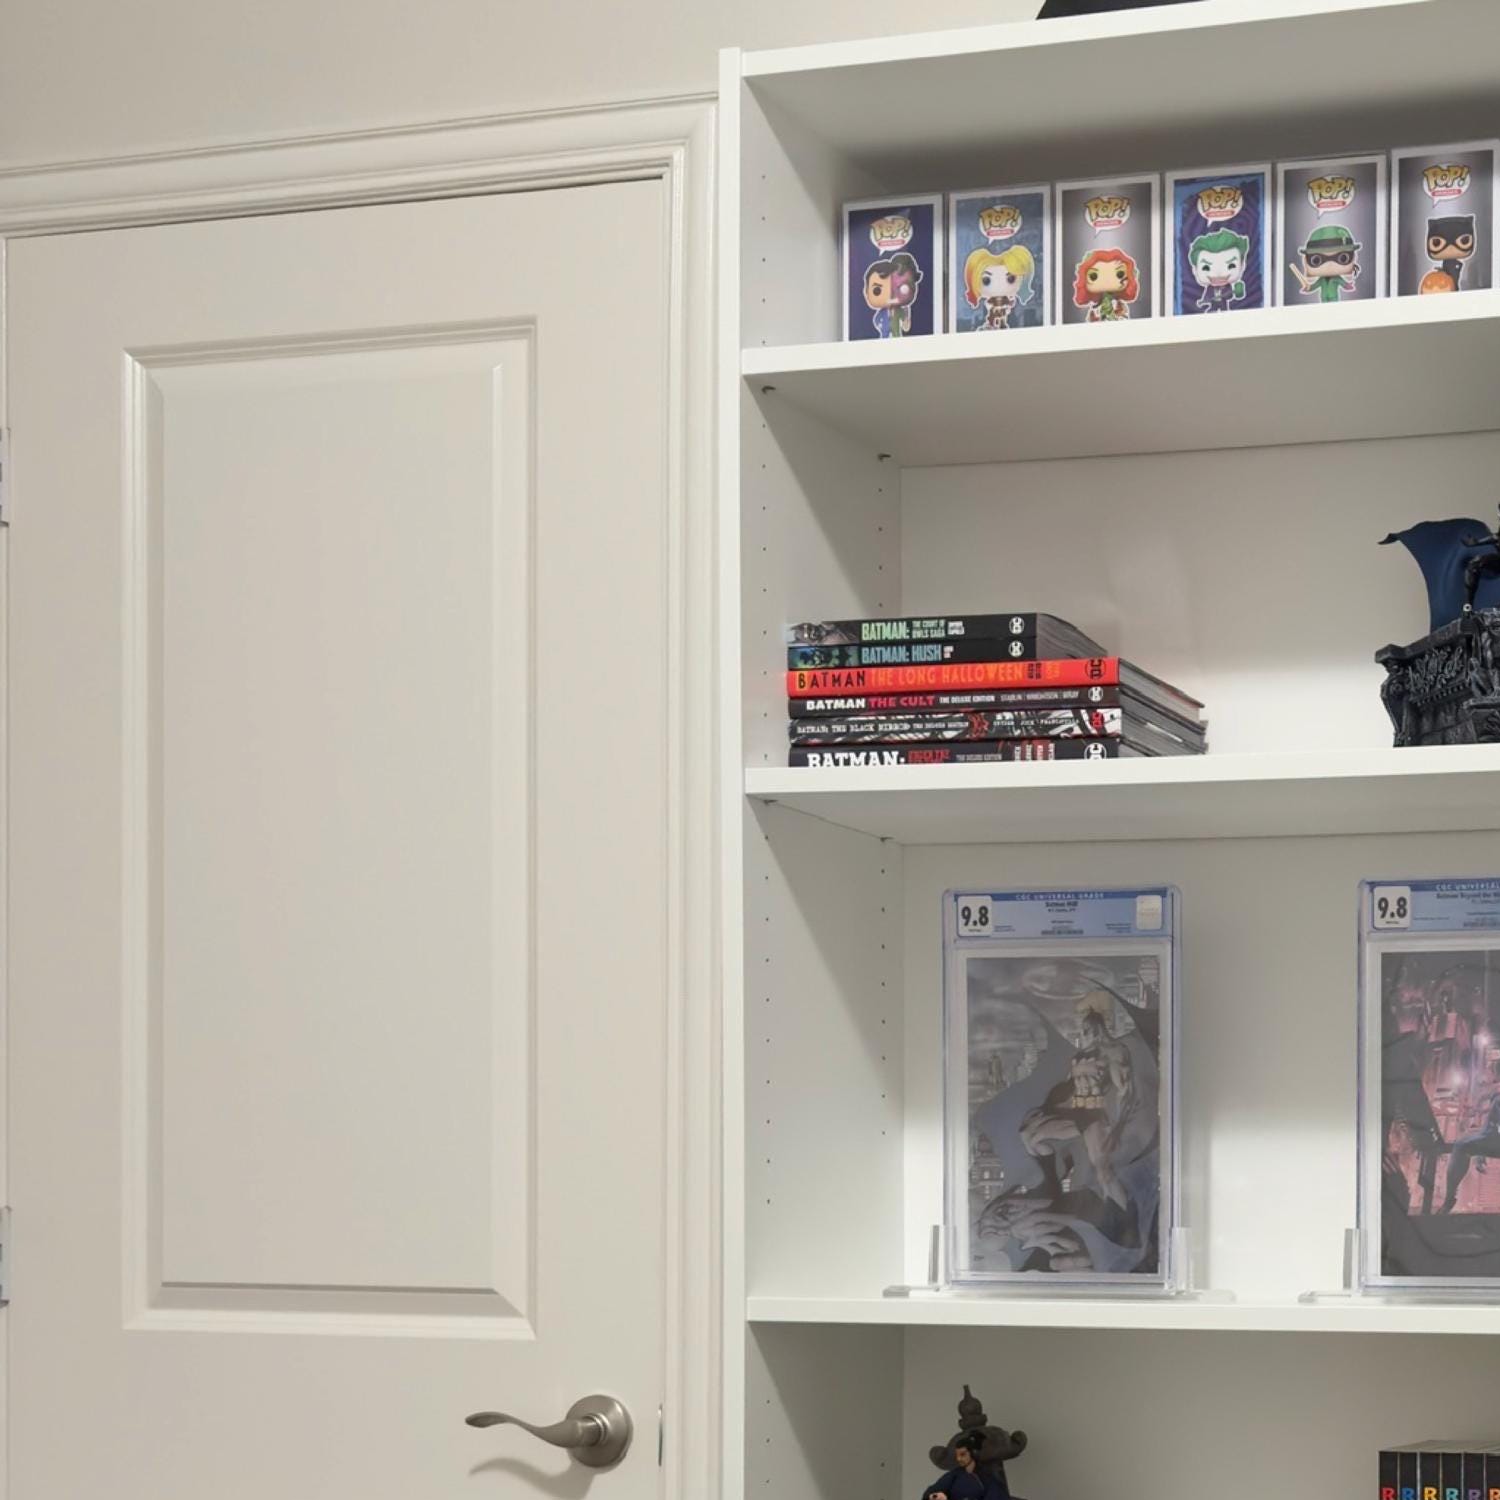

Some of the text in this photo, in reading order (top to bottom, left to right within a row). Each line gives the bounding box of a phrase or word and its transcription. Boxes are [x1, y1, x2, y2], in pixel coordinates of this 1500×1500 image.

[1307, 177, 1355, 202] POP!
[1422, 165, 1471, 191] POP!
[1084, 197, 1131, 221] POP!
[1198, 187, 1243, 211] POP!
[871, 217, 911, 241] POP!
[979, 207, 1020, 231] POP!
[862, 622, 910, 640] BATMAN:
[862, 646, 910, 664] BATMAN:
[912, 644, 942, 662] HUSH
[797, 662, 1023, 690] BATMAN THE LONG HALLOWEEN
[806, 699, 866, 710] BATMAN
[870, 698, 896, 708] THE
[900, 696, 935, 706] CULT
[961, 906, 989, 926] 9.8
[1378, 897, 1408, 918] 9.8
